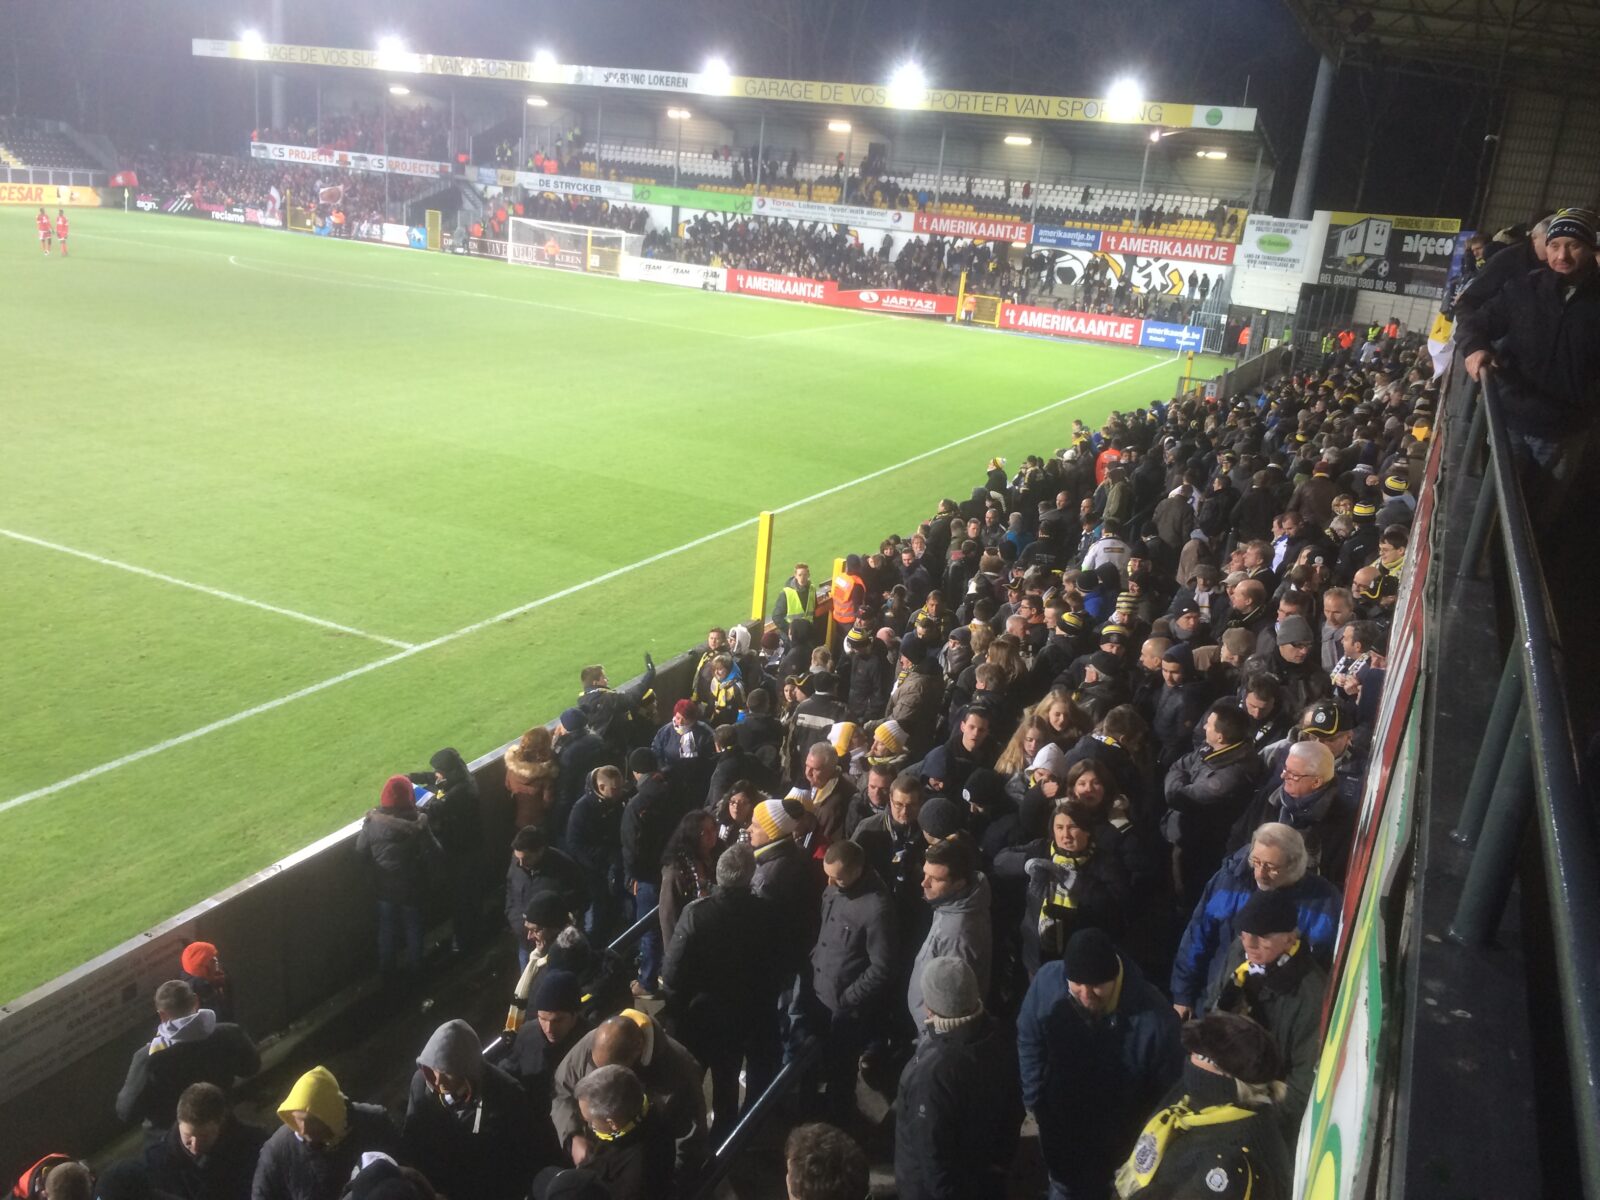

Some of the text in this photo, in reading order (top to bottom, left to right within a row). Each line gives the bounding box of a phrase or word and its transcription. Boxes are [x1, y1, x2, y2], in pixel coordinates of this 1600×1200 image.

[300, 47, 317, 63] DE
[321, 49, 348, 66] VOS
[647, 73, 689, 88] LOKEREN
[744, 79, 815, 100] GARAGE
[819, 84, 844, 101] DE
[850, 86, 887, 105] VOS
[1014, 96, 1050, 116] VAN
[538, 178, 551, 188] DE
[553, 180, 602, 194] STRYCKER
[211, 209, 245, 224] reclame
[929, 217, 1028, 241] AMERIKAANTJE
[544, 251, 582, 265] LKEREN
[1118, 237, 1229, 262] AMERIKAANTJE
[745, 275, 825, 299] AMERIKAANTJE
[882, 295, 937, 310] JARTAZI
[1018, 310, 1135, 341] AMERIKAANTJE
